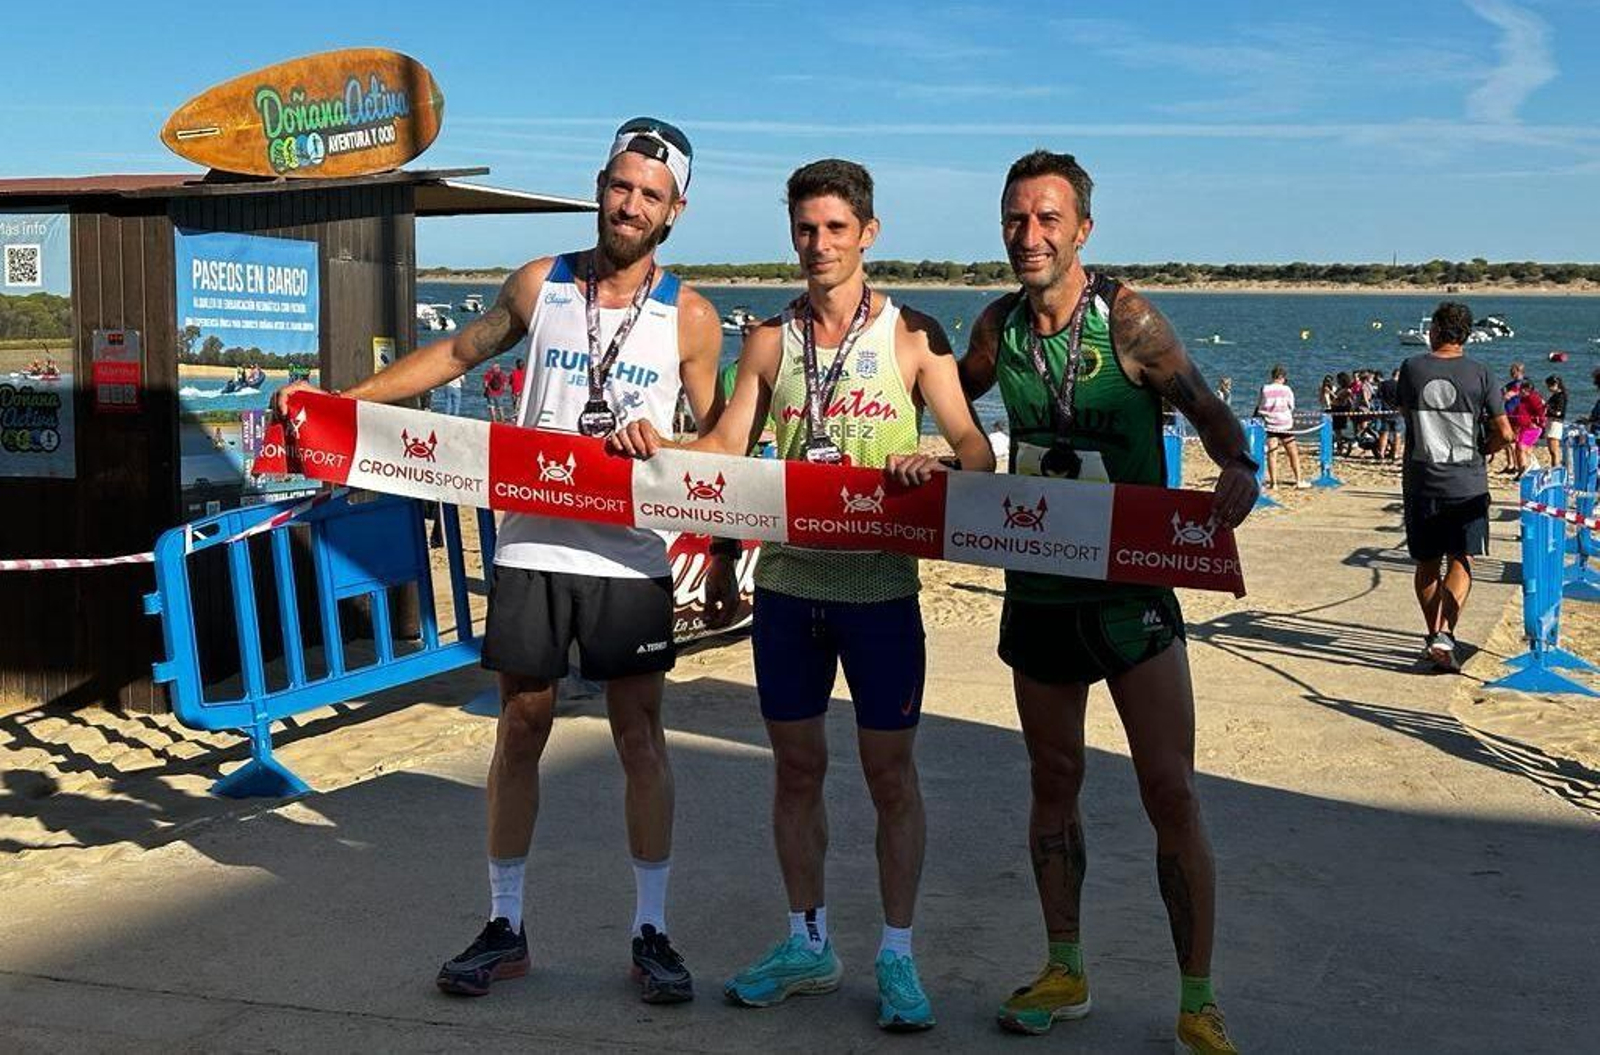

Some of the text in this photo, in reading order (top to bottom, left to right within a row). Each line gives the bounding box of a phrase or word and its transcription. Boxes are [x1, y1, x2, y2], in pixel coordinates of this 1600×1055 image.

[328, 124, 396, 153] AVENTURA Y OCIO
[23, 221, 47, 235] info
[192, 258, 309, 297] PASEOS EN BARCO
